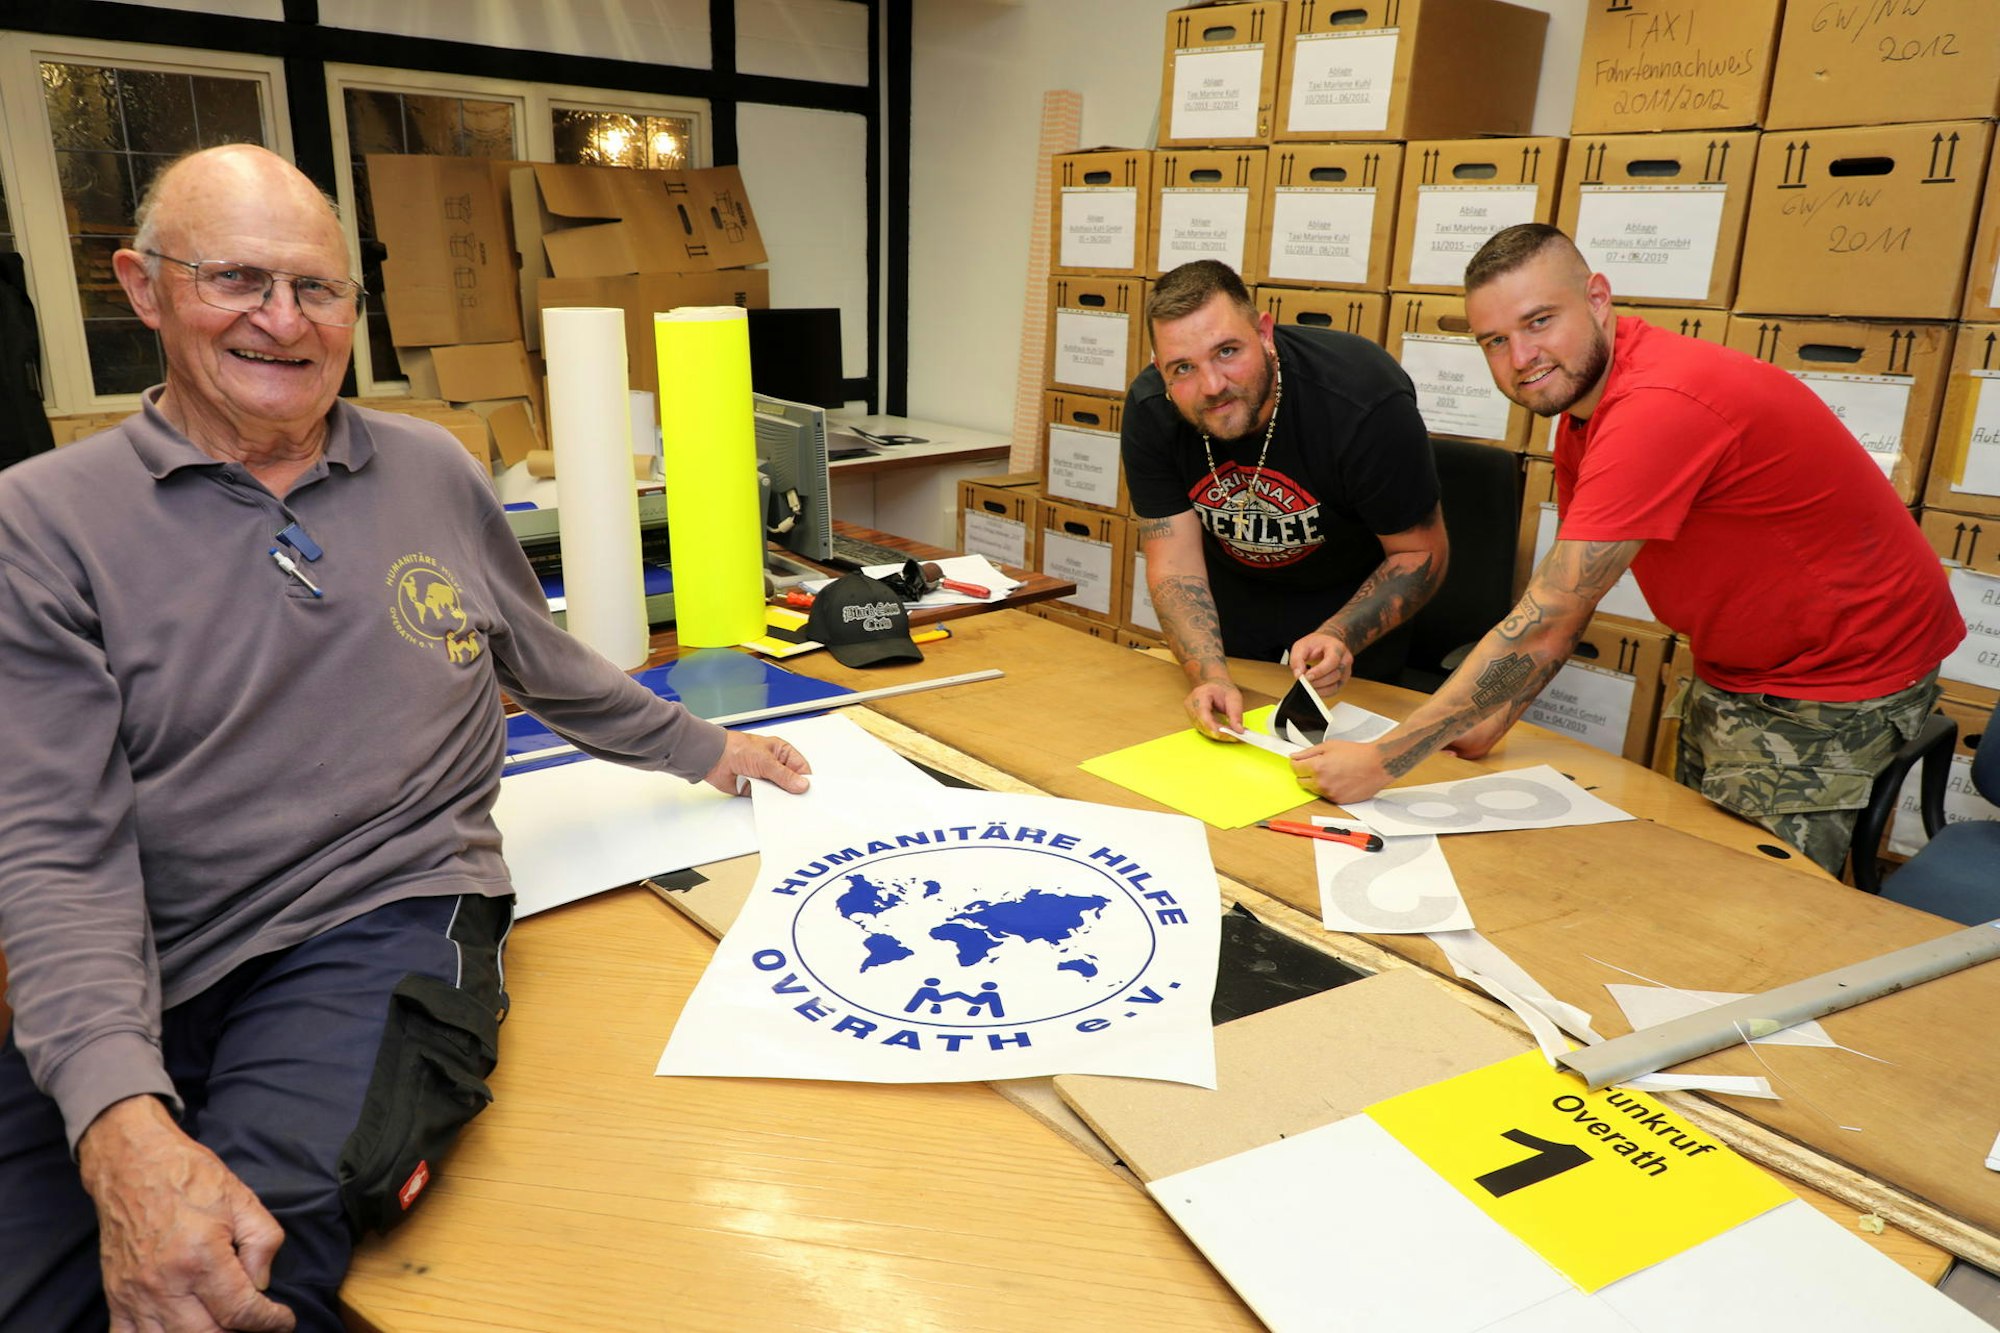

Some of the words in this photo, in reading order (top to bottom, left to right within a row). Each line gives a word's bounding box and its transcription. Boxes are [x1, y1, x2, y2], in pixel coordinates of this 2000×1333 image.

[1624, 10, 1694, 48] TAXI
[1879, 33, 1960, 62] 2012
[1327, 67, 1353, 78] Ablage
[1596, 48, 1754, 87] Fahrtennachweis
[1308, 80, 1322, 91] Taxi
[1613, 84, 1731, 116] 2011/2012
[1459, 205, 1488, 218] Ablage
[1288, 232, 1302, 243] Taxi
[1435, 223, 1453, 234] Taxi
[1454, 223, 1488, 235] Marlene
[1625, 223, 1658, 235] Ablage
[1829, 225, 1911, 253] 2011
[1431, 240, 1464, 252] 11/2015
[1590, 238, 1634, 250] Autohaus
[1636, 239, 1658, 250] Kuhl
[1659, 239, 1692, 251] GmbH
[1230, 546, 1305, 563] OXING
[385, 551, 437, 587] HUMANITÄRE
[771, 821, 1082, 897] HUMANITÄRE
[1088, 846, 1188, 928] HILFE
[751, 948, 1033, 1053] OVERATH
[1551, 1094, 1669, 1177] Overath
[1604, 1086, 1717, 1157] unkruf
[1473, 1127, 1595, 1199] 1
